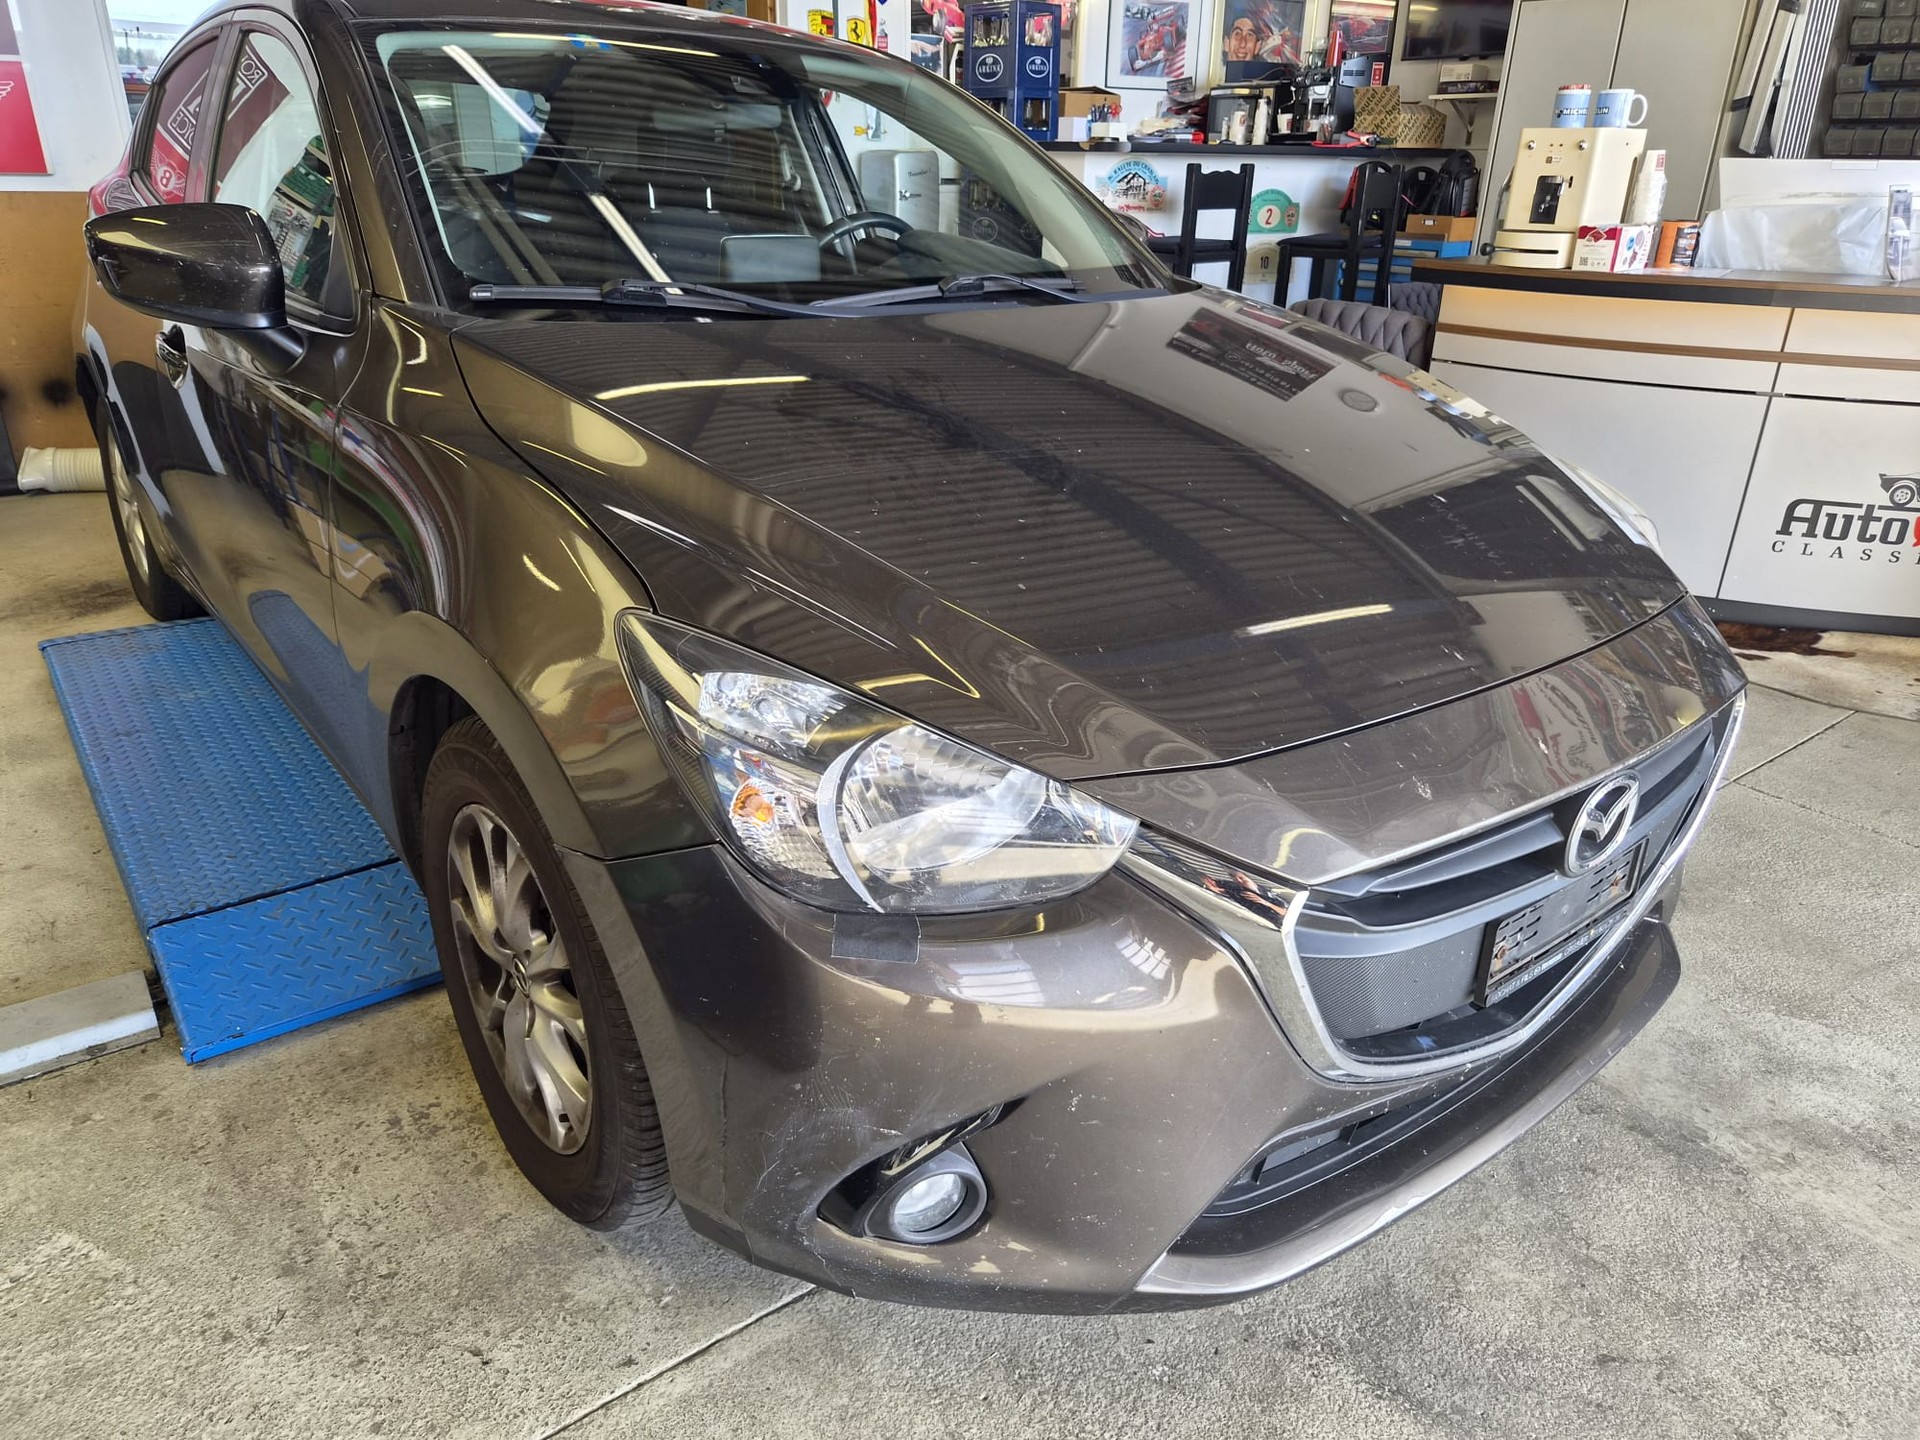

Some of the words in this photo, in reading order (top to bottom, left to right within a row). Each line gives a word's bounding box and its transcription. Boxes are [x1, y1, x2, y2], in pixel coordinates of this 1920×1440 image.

[1265, 208, 1273, 225] 2
[1260, 256, 1269, 269] 10
[1775, 498, 1910, 545] Auto
